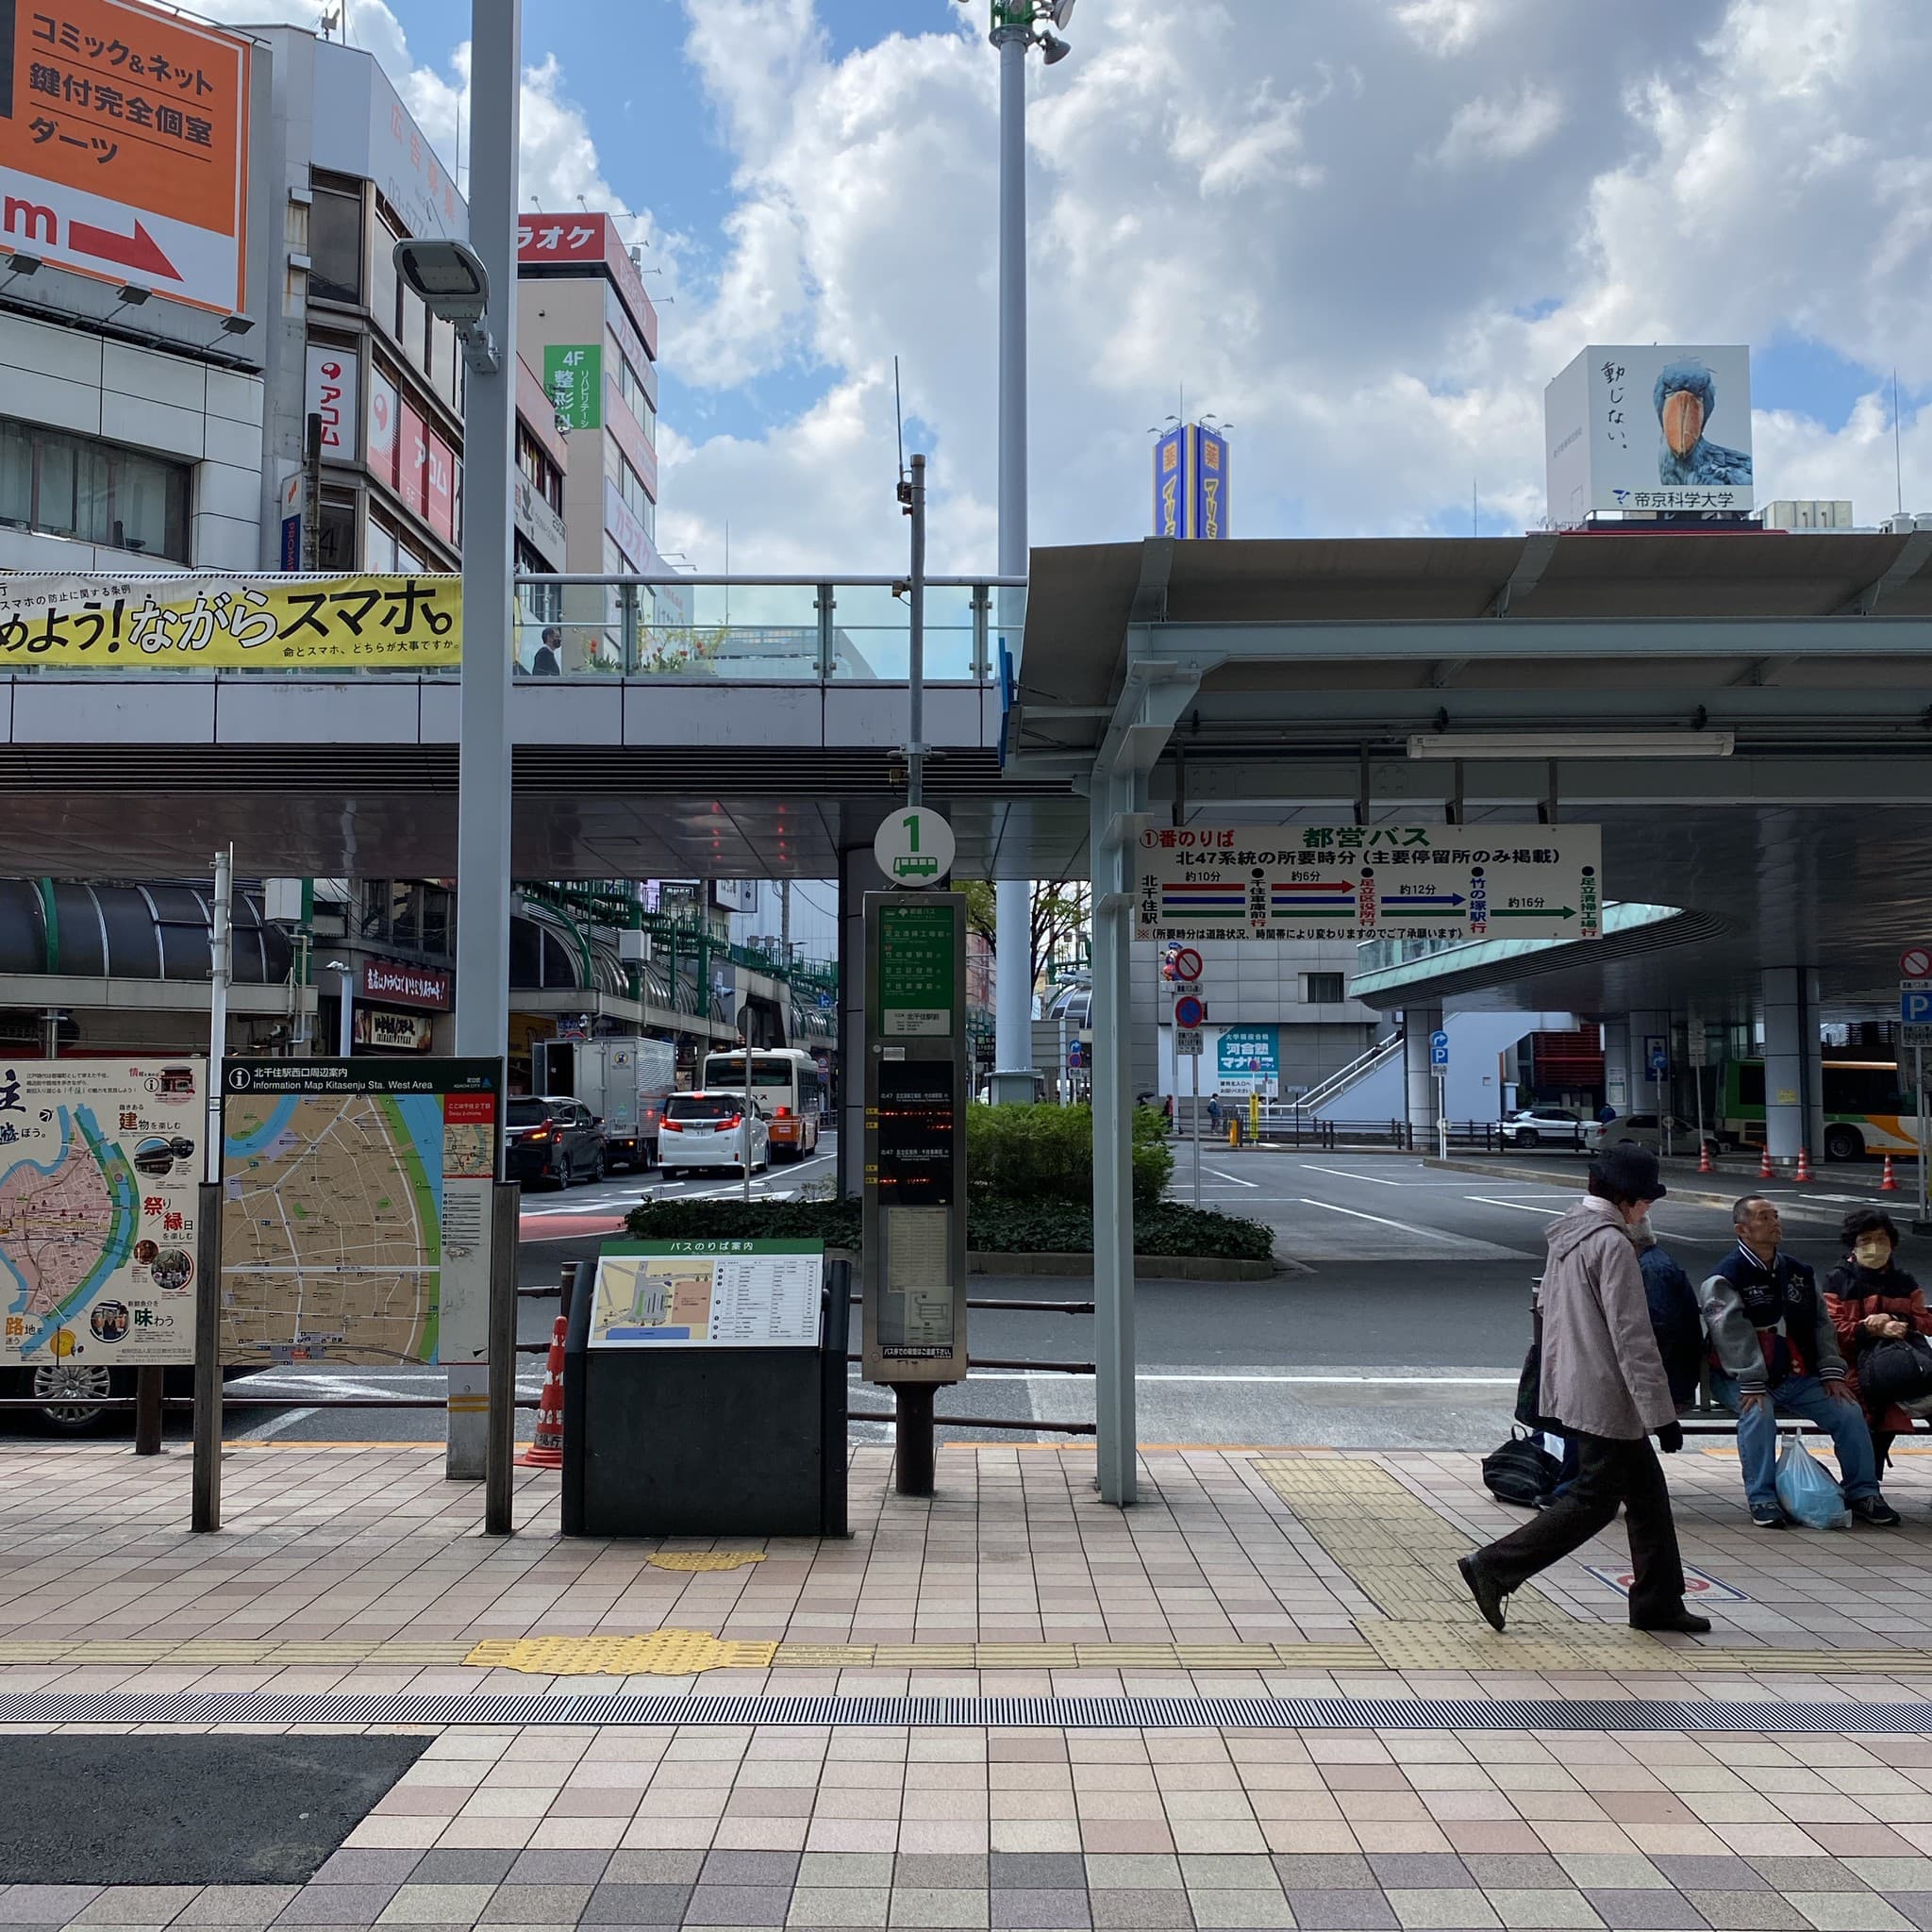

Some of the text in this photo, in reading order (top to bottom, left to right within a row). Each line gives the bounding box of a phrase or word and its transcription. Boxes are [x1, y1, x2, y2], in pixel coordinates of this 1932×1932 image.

[32, 13, 213, 95] コミック&ネット
[30, 62, 212, 147] 鍵付完全個室
[29, 116, 118, 164] ダーツ
[4, 196, 57, 245] m
[563, 350, 585, 366] 4F
[1600, 360, 1628, 450] 動じない。
[321, 385, 341, 448] アコム
[414, 435, 448, 498] アコム
[1634, 491, 1735, 508] 帝京科学大学
[903, 815, 920, 852] 1
[1303, 826, 1431, 848] 都営バス
[1185, 872, 1222, 882] 約10分
[1291, 871, 1322, 882] 約6分
[1141, 875, 1158, 924] 北千住駅
[1400, 884, 1437, 895] 約12分
[1359, 878, 1376, 927] 足立区役所行
[1470, 877, 1487, 934] 竹の塚駅行
[1508, 897, 1545, 908] 約16分
[1580, 877, 1597, 937] 足立清掃工場行
[1909, 995, 1929, 1020] P
[1226, 1042, 1269, 1055] 河合塾
[1436, 1049, 1445, 1062] P
[253, 1067, 348, 1077] 北千住駅西口周辺案内
[253, 1080, 433, 1091] Information Map Kitasenju Sta. West Area
[120, 1112, 181, 1130] 建物を楽しむ
[144, 1196, 171, 1216] 祭り
[164, 1212, 192, 1231] 縁日
[670, 1241, 755, 1252] バスのりば案内
[135, 1307, 174, 1327] 味わう
